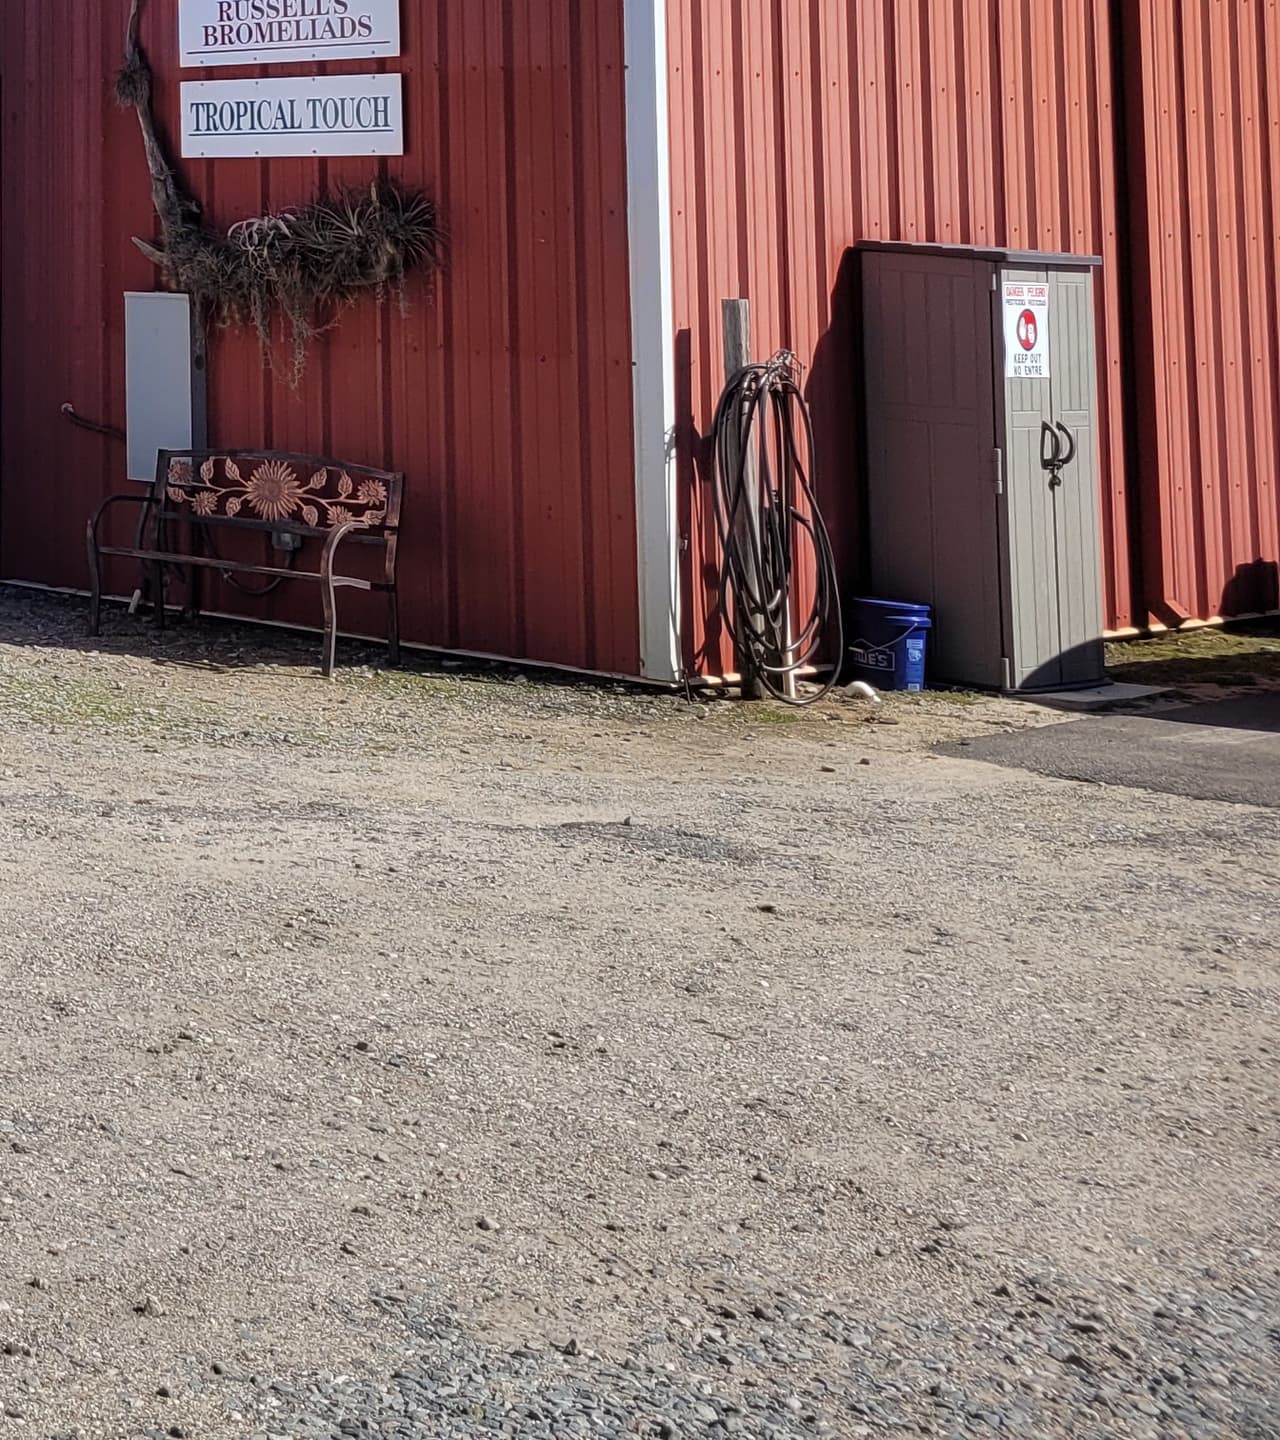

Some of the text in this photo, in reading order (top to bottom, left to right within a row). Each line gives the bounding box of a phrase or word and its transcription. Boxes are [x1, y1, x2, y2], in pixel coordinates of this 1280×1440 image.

[202, 15, 373, 47] BROMELIADS
[190, 96, 391, 133] TROPICAL TOUCH
[1013, 353, 1042, 364] KEEP OUT
[1013, 365, 1042, 376] NO ENTRE
